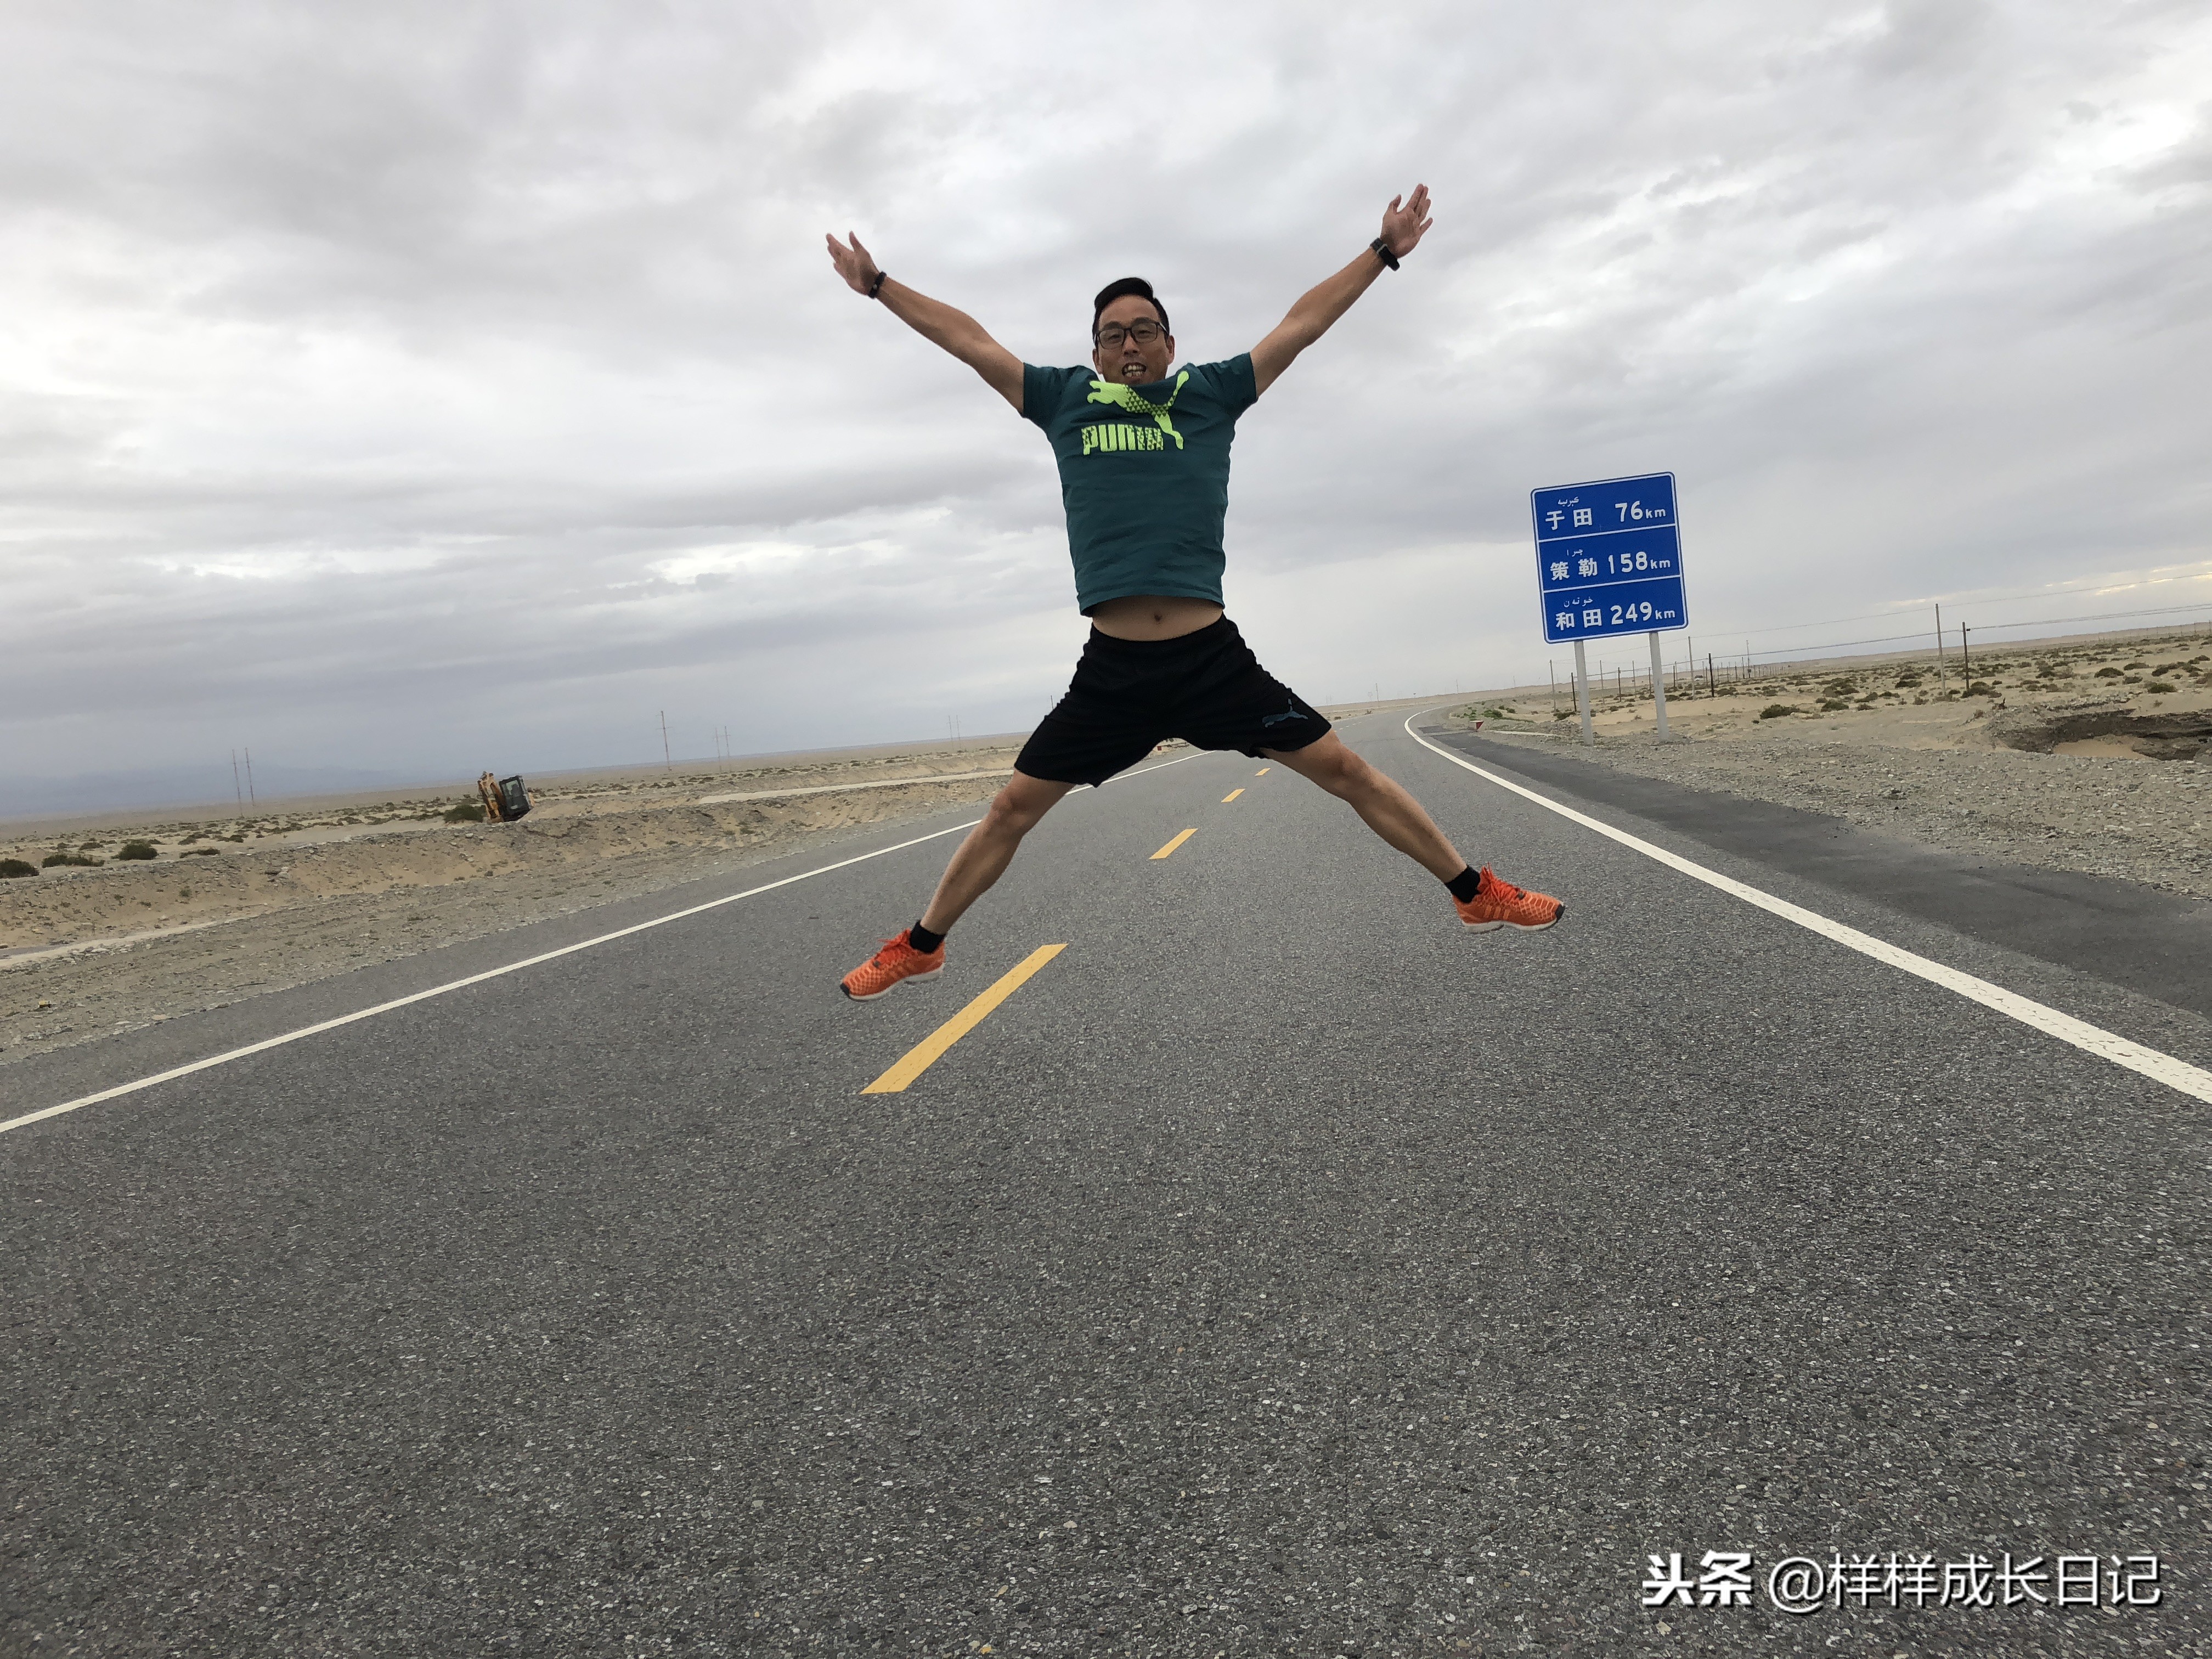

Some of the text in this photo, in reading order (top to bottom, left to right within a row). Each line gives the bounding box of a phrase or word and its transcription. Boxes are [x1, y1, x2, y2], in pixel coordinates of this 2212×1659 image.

[1545, 500, 1666, 531] 于田 76km
[1550, 551, 1671, 581] 策勒 158km
[1555, 601, 1675, 631] 和田 249km
